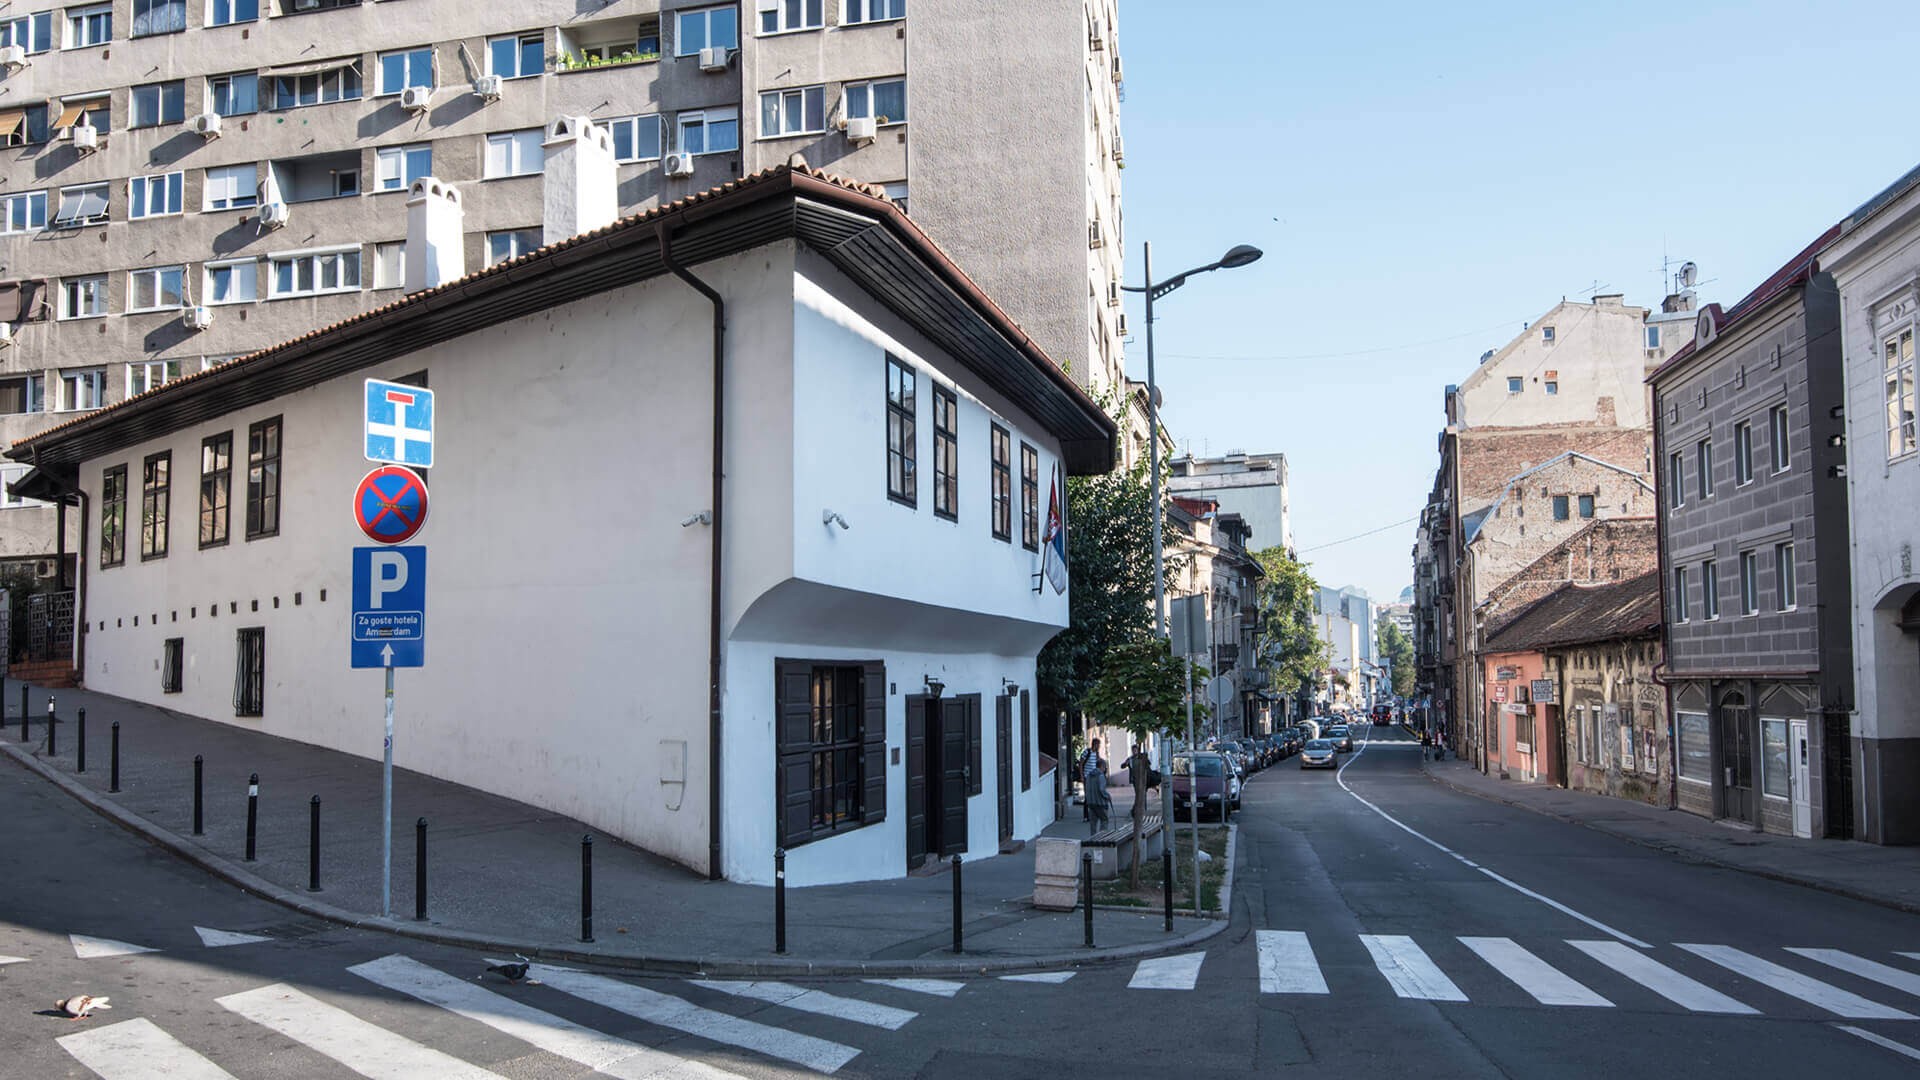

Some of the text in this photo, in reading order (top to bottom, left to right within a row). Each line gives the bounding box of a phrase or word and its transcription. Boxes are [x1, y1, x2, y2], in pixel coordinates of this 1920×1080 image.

[370, 551, 408, 609] P
[359, 615, 418, 627] Za goste hotela
